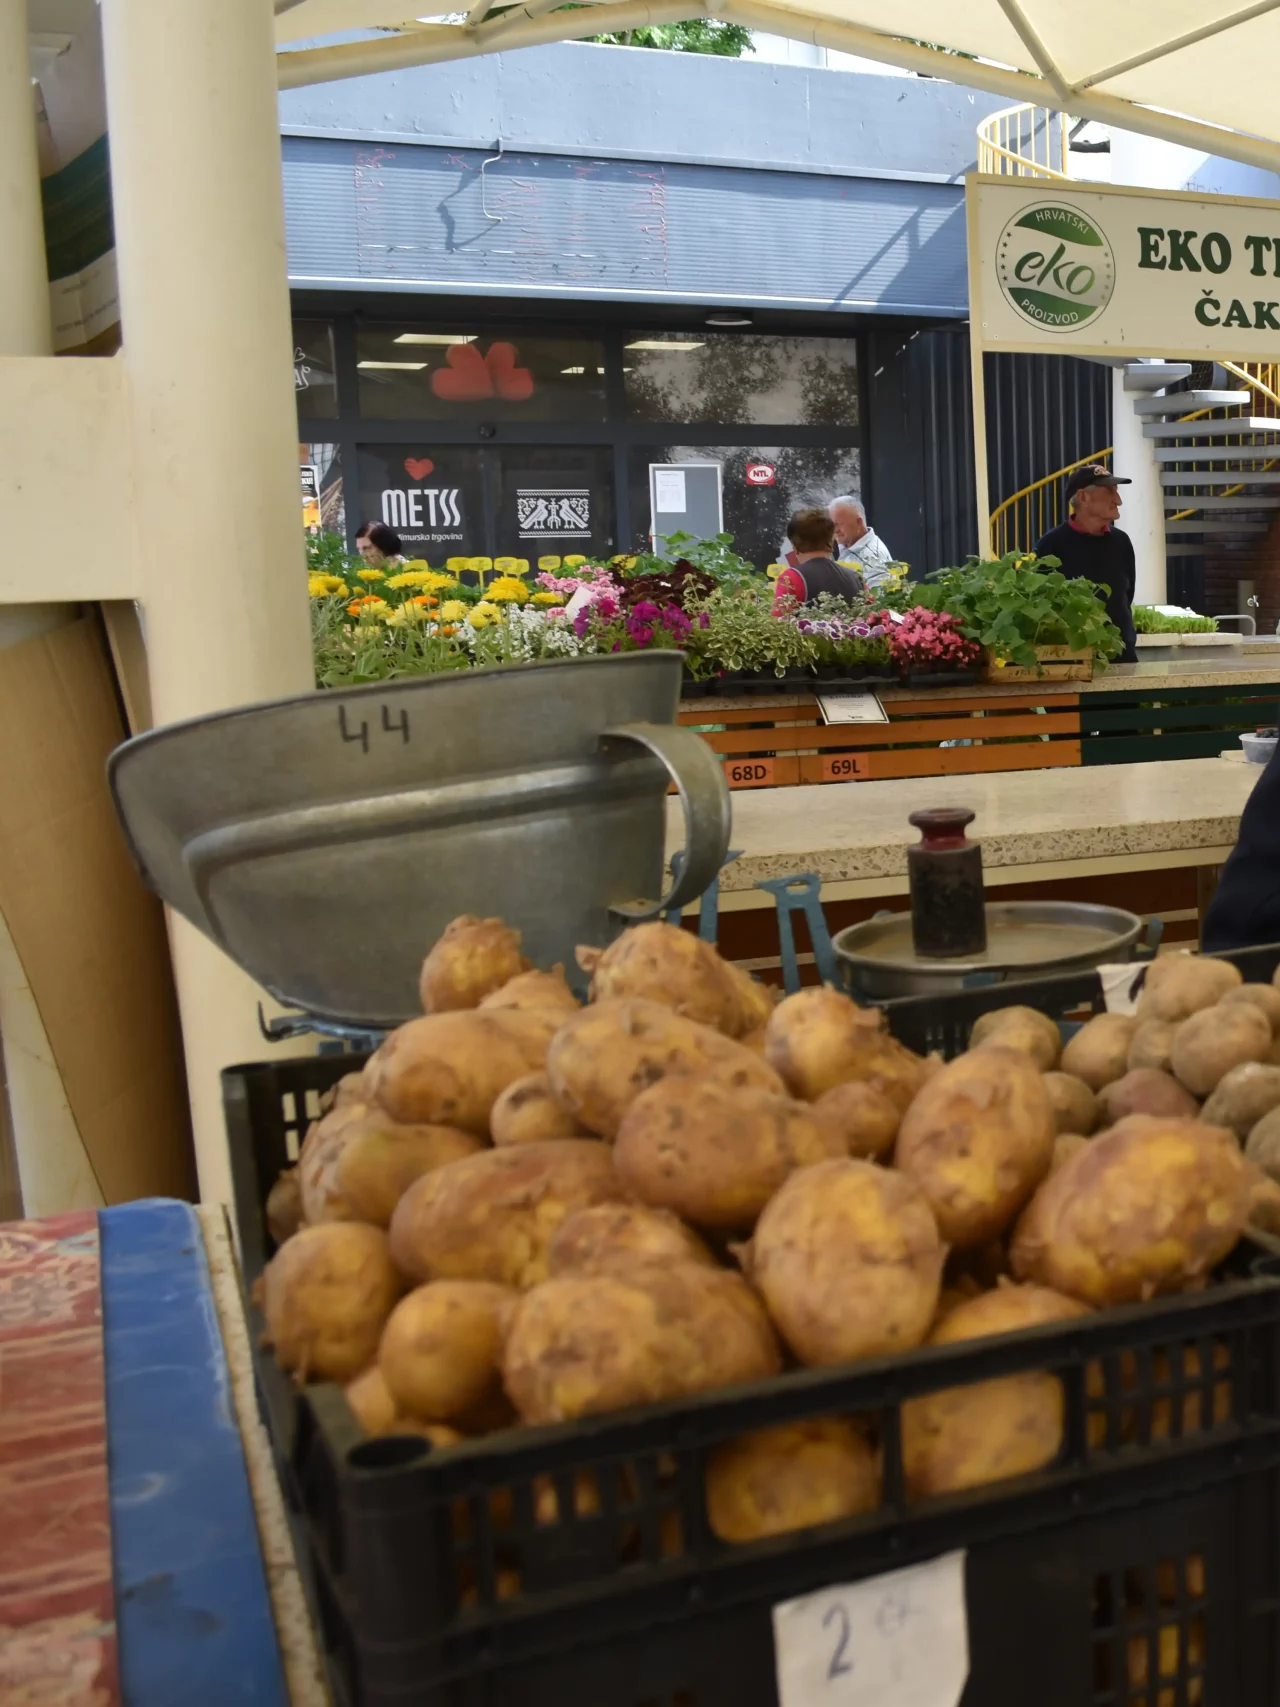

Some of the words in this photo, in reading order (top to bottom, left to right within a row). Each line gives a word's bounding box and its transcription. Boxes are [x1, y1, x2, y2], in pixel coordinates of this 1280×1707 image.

[1035, 210, 1089, 234] HRVATSKI
[1136, 226, 1232, 274] EKO
[1014, 242, 1095, 295] eko
[1021, 299, 1079, 324] PROIZVOD
[381, 488, 461, 527] METSS
[431, 533, 463, 542] trgovina
[731, 765, 767, 781] 68D
[830, 759, 861, 775] 69L
[821, 1601, 855, 1681] 2
